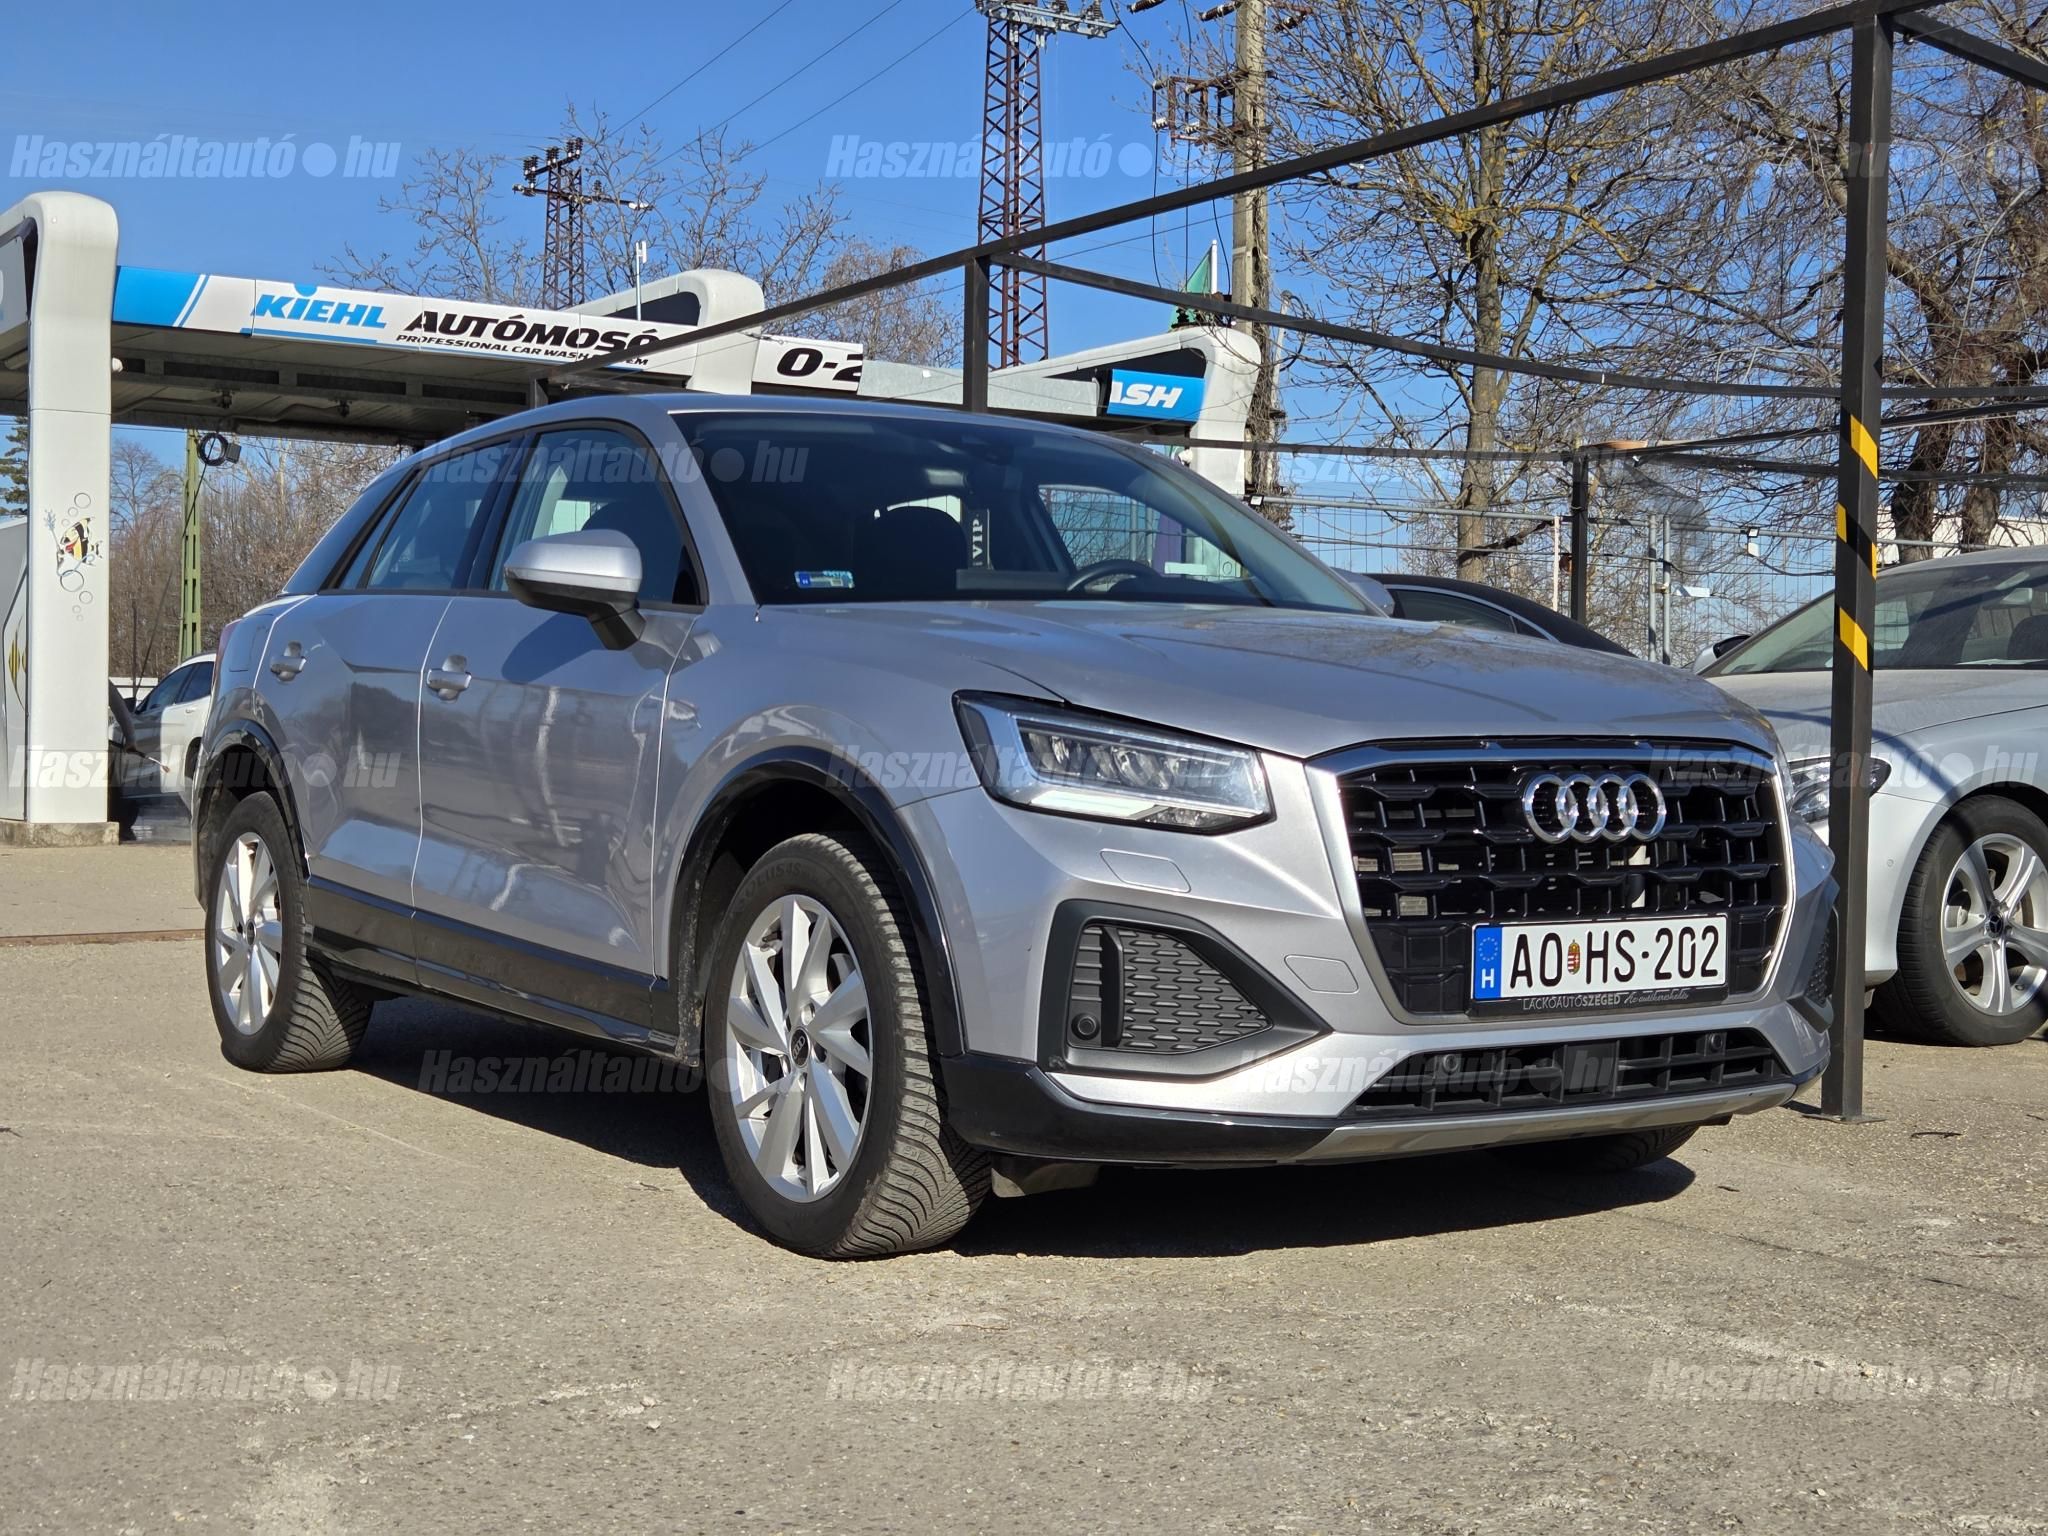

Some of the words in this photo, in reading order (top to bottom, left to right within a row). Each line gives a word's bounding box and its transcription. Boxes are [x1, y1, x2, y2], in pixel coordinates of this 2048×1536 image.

[395, 334, 510, 353] PROFESSIONAL
[511, 345, 542, 356] CAR
[543, 349, 590, 360] WASH
[1481, 967, 1494, 989] H
